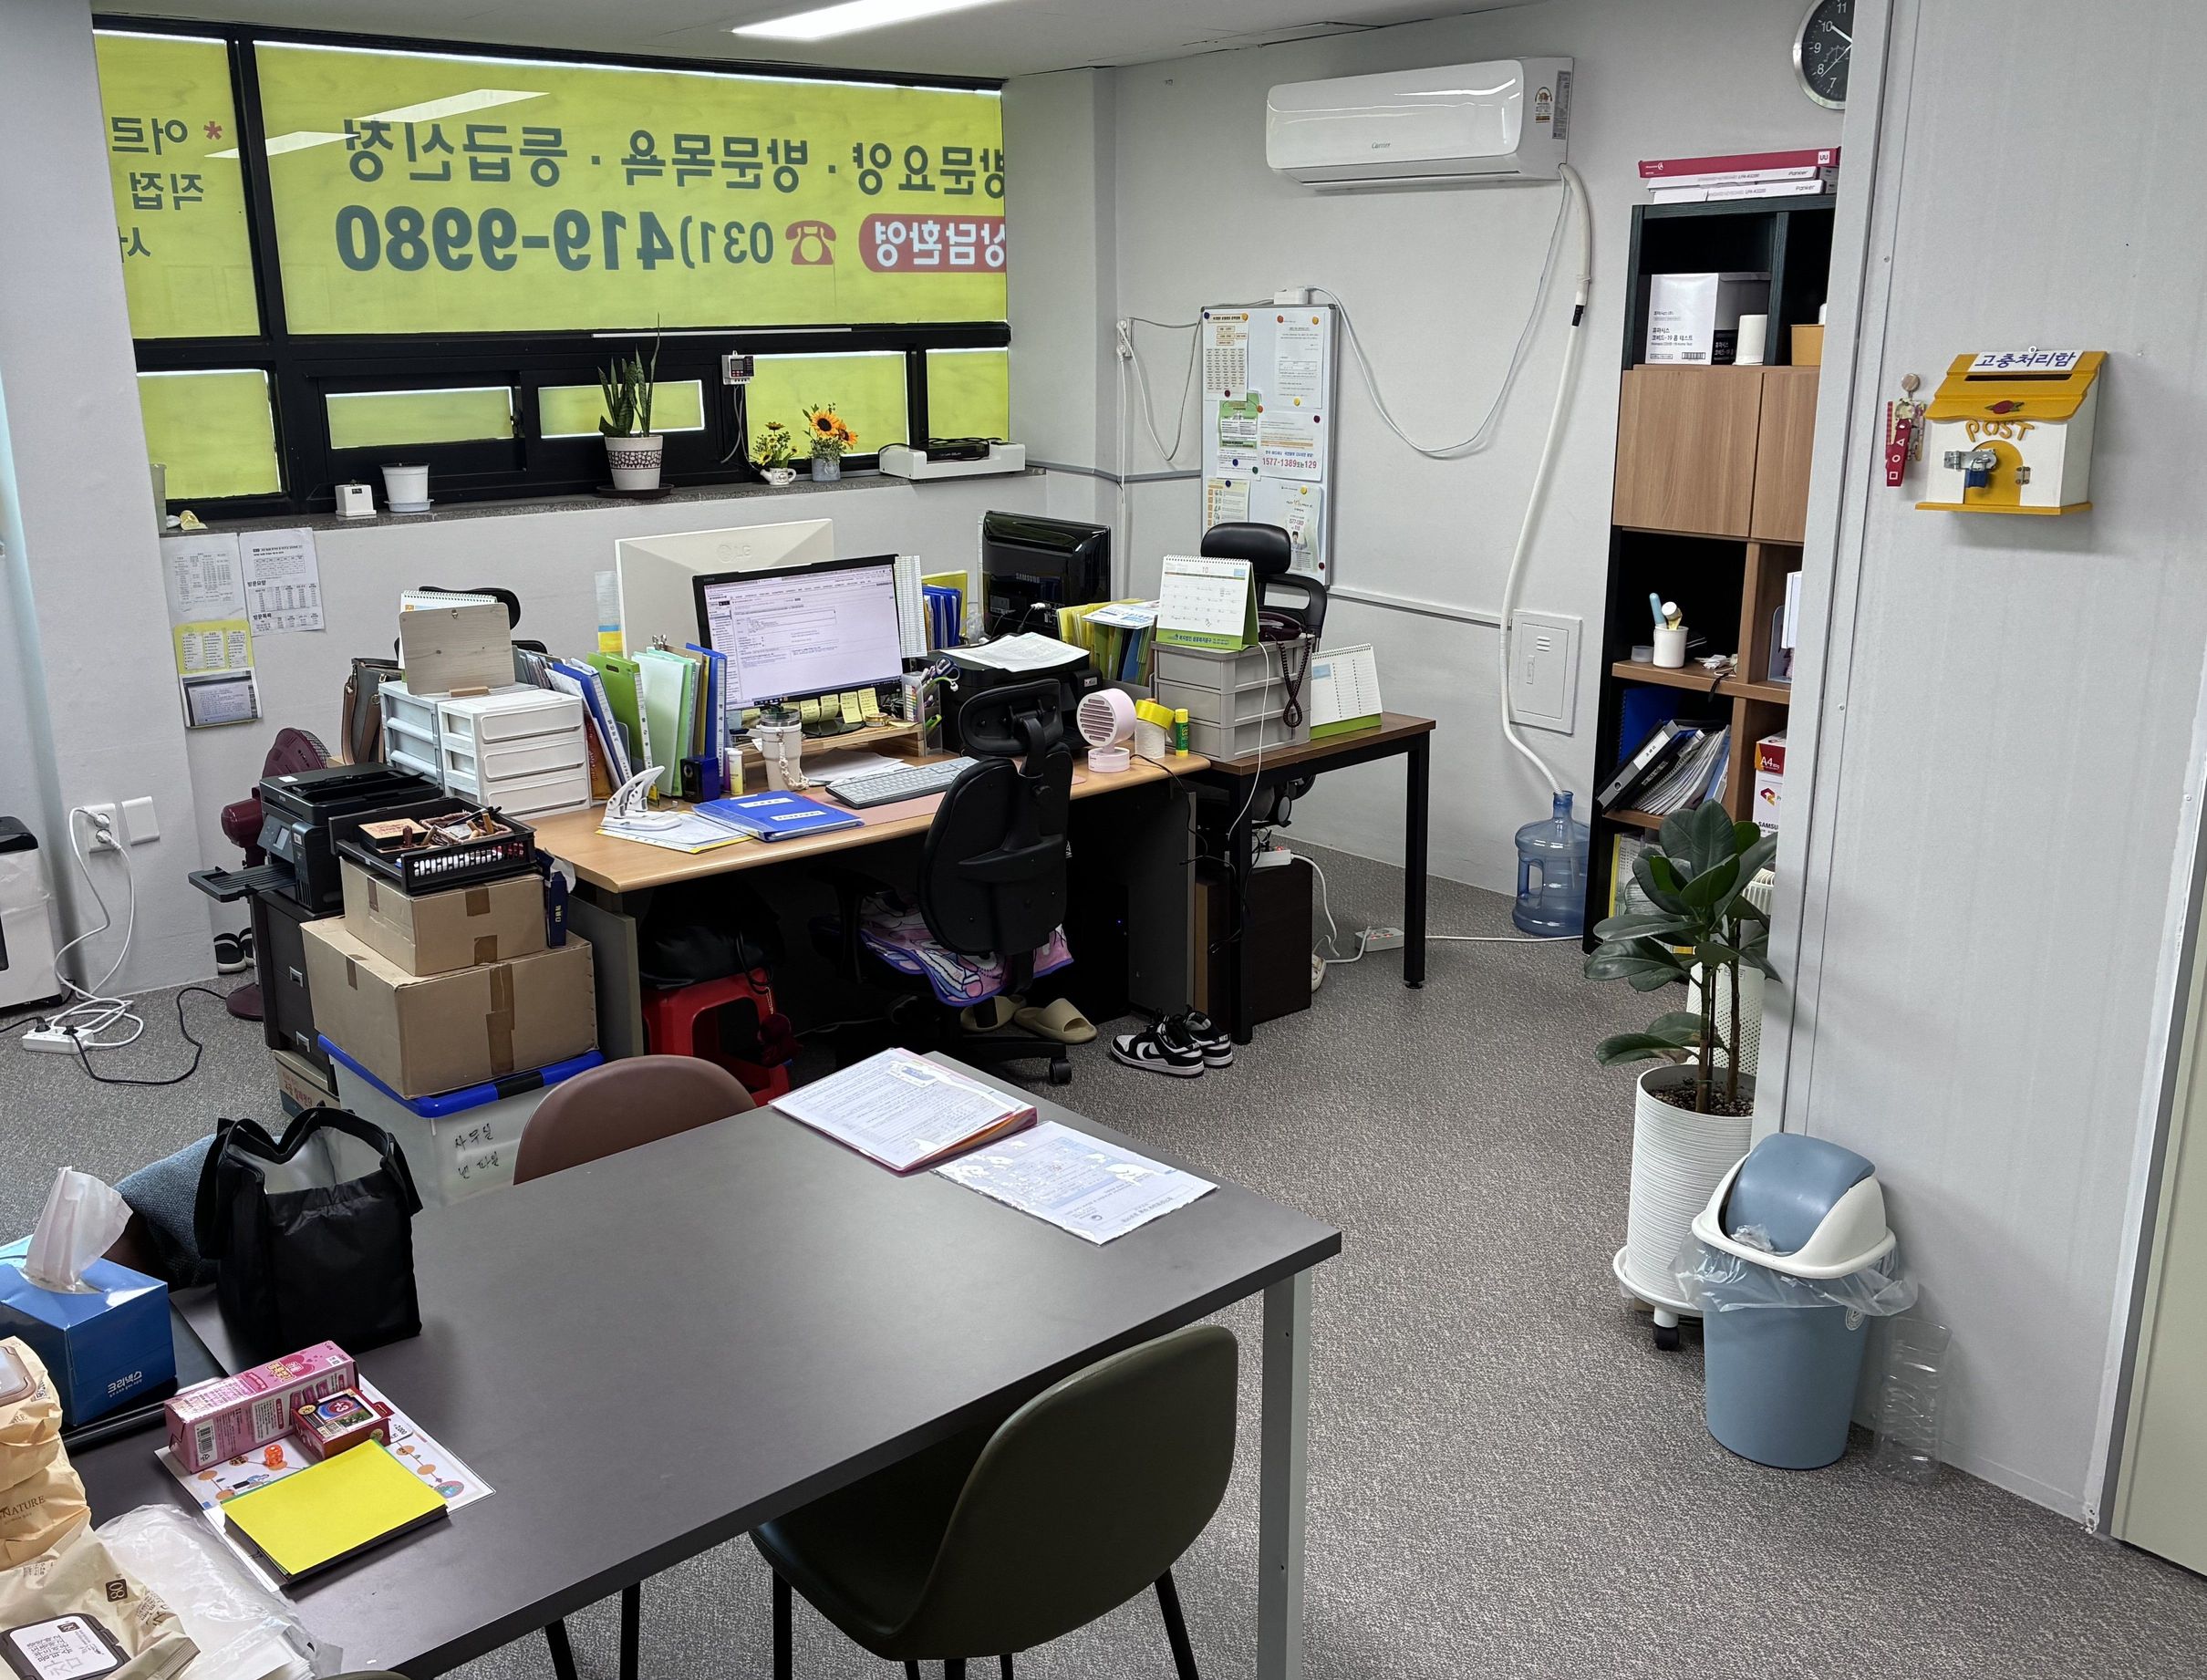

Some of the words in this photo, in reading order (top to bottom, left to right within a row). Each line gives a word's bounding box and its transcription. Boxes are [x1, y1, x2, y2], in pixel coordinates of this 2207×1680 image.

[1821, 20, 1833, 33] 10
[1813, 42, 1822, 54] 9
[1817, 63, 1825, 75] 8
[1829, 77, 1838, 88] 7
[1974, 351, 2076, 368] 고충처리함
[1965, 419, 2035, 442] POST
[1760, 756, 1773, 767] A4
[109, 1581, 126, 1600] 80
